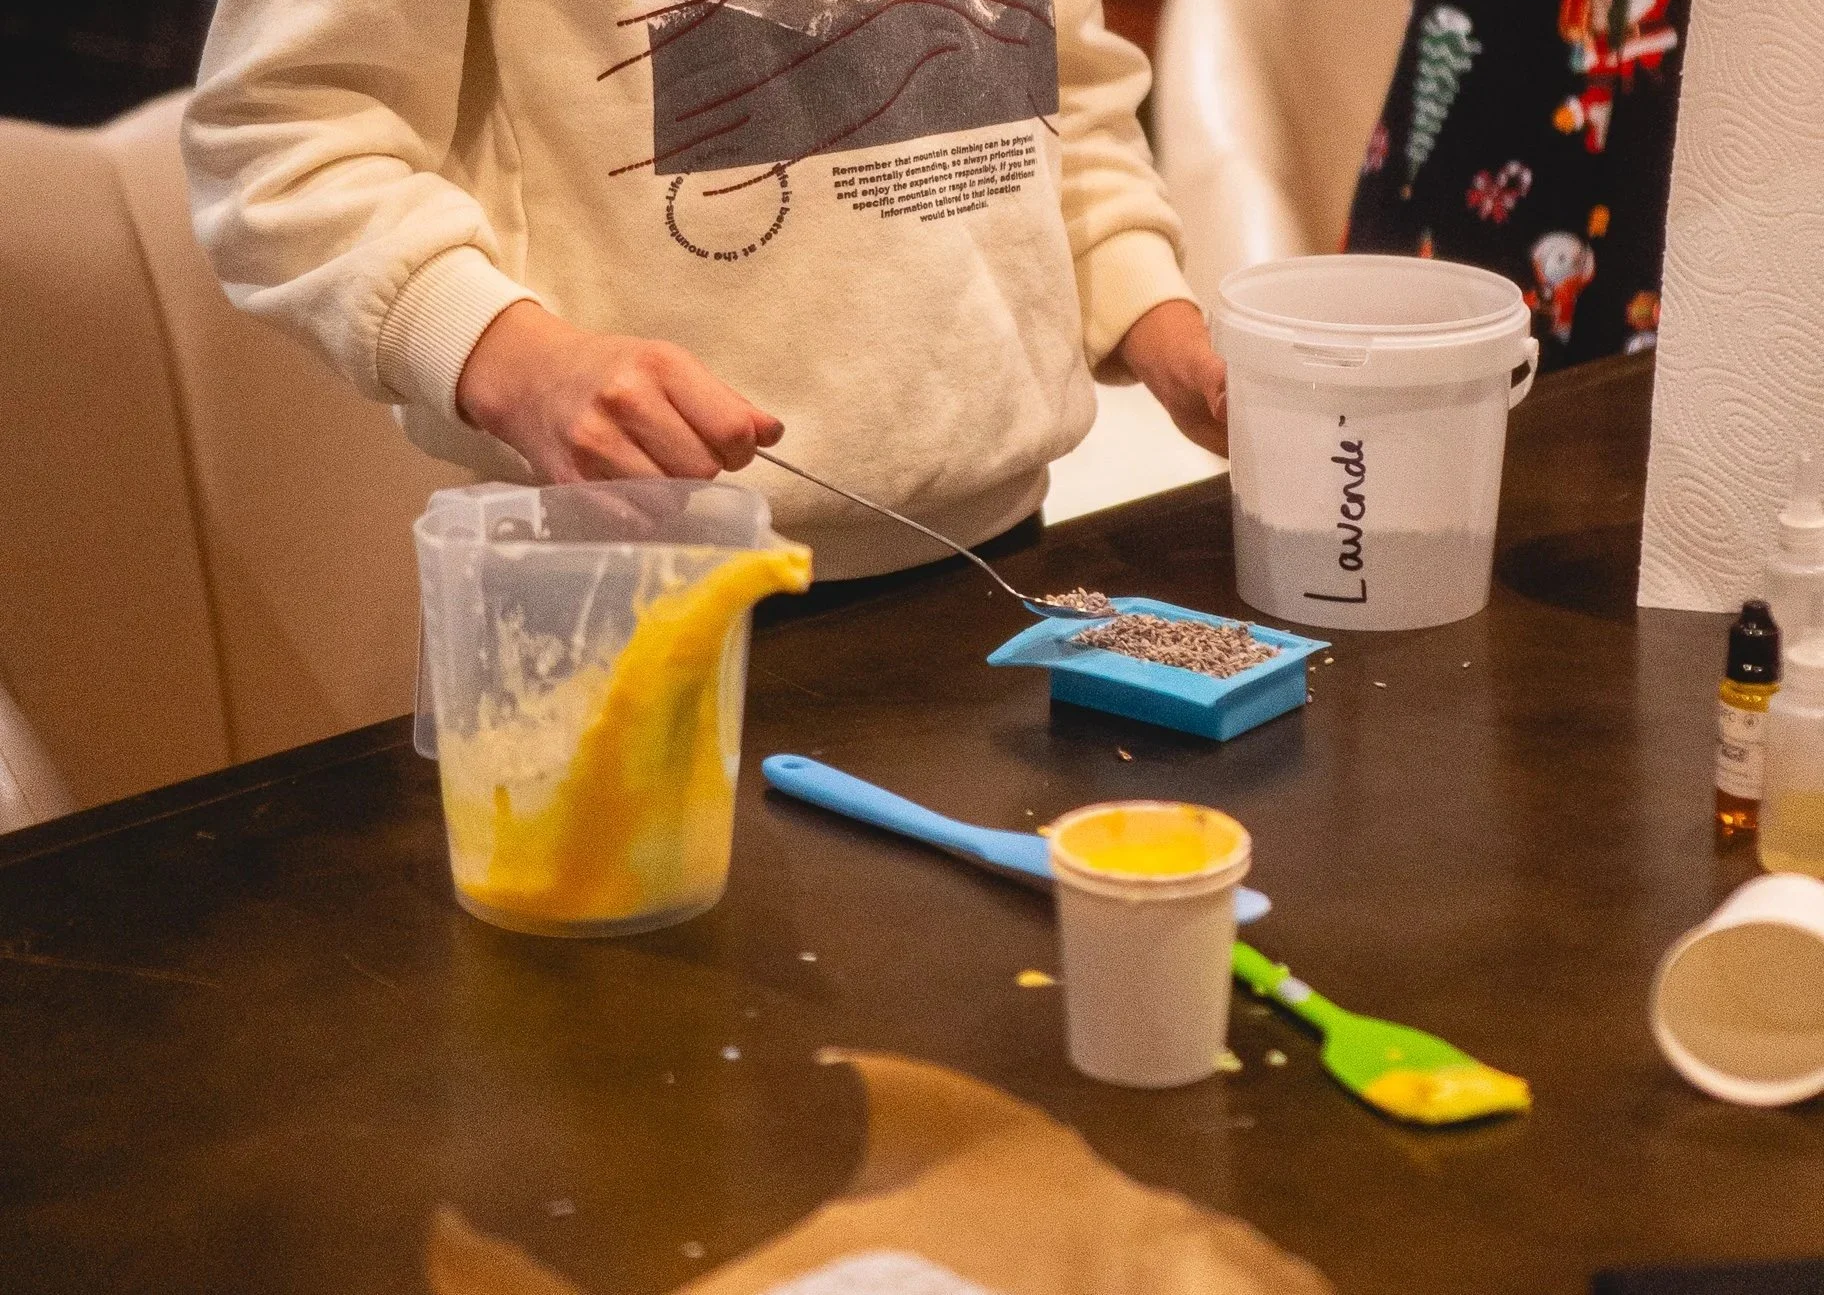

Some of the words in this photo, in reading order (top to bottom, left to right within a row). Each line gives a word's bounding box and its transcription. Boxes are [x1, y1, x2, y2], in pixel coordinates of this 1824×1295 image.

[832, 161, 892, 176] Remember
[895, 156, 911, 167] that
[912, 149, 948, 163] mountain
[951, 143, 983, 155] climbing
[985, 141, 998, 150] can
[1000, 138, 1010, 147] be
[834, 177, 855, 188] and
[859, 170, 903, 185] mentally
[906, 161, 950, 177] demanding,
[952, 159, 961, 167] so
[963, 154, 988, 165] always
[990, 147, 1024, 162] prioritize
[837, 189, 858, 200] and
[861, 185, 890, 197] enjoy
[893, 182, 907, 192] the
[909, 172, 952, 189] experience
[1000, 161, 1007, 171] If
[1008, 161, 1022, 172] you
[853, 196, 895, 211] specific
[898, 188, 937, 203] mountain
[939, 186, 947, 194] or
[949, 182, 967, 192] range
[969, 179, 976, 187] in
[935, 194, 962, 207] tailored
[963, 193, 970, 201] to
[971, 189, 985, 198] that
[987, 184, 1021, 196] location
[760, 207, 791, 246] better
[920, 209, 945, 222] would
[947, 207, 955, 217] be
[714, 251, 738, 262] the
[742, 243, 757, 257] at
[1303, 415, 1367, 603] Lavende
